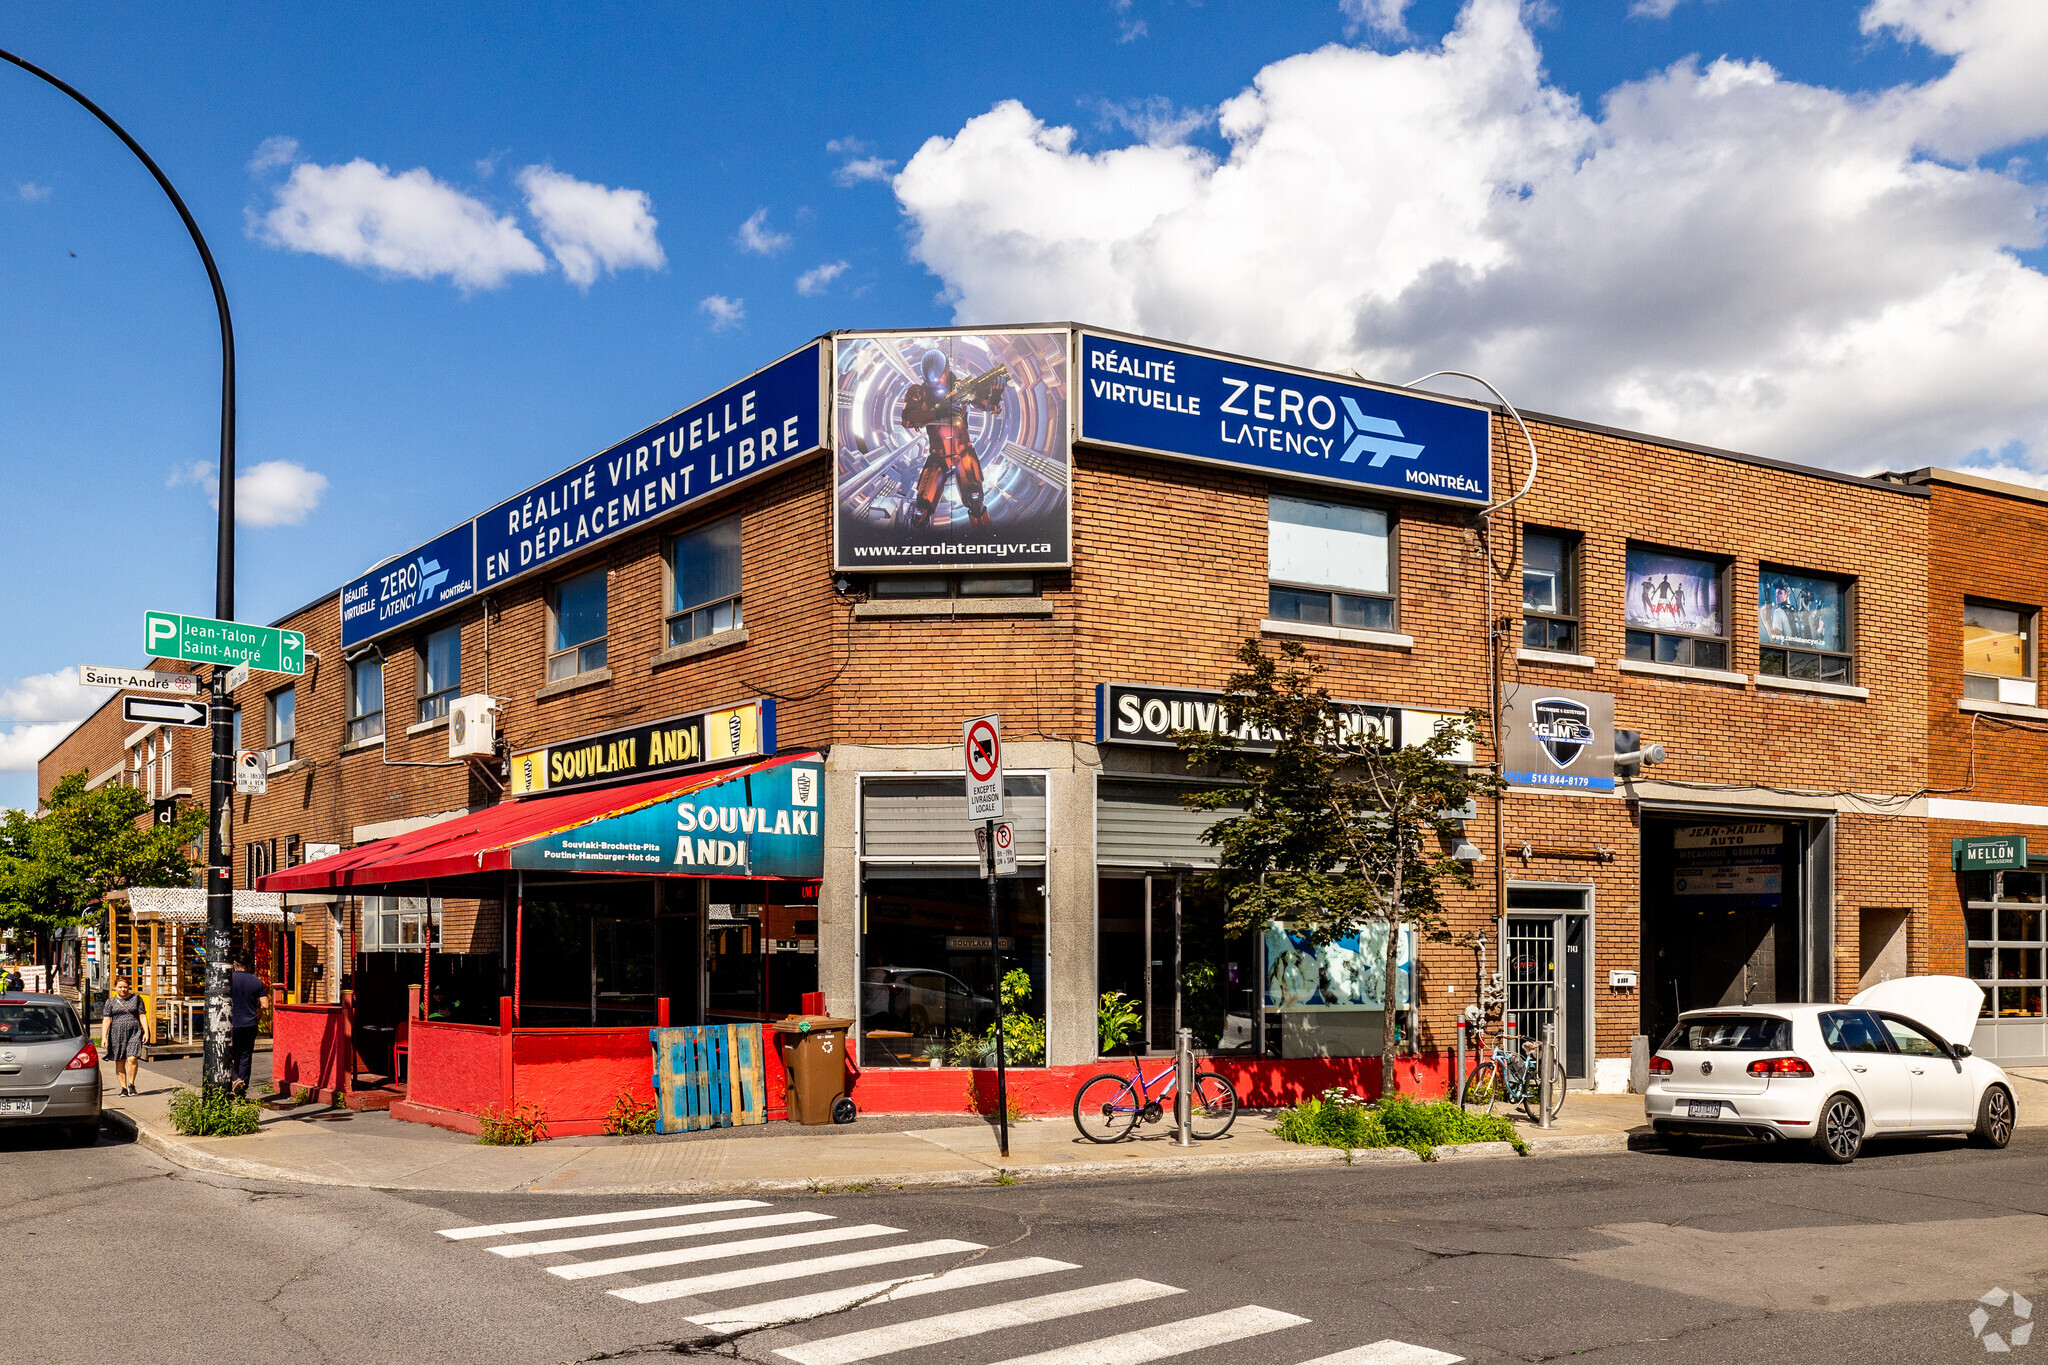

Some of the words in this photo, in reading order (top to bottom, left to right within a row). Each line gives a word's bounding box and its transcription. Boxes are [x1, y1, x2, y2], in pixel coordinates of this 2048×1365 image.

[1091, 350, 1176, 384] RÉALITÉ
[1090, 378, 1200, 416] VIRTUELLE
[1220, 376, 1336, 430] ZERO
[1222, 420, 1334, 460] LATENCY
[508, 464, 596, 536] RÉALITÉ
[608, 390, 756, 486] VIRTUELLE
[1406, 468, 1482, 494] MONTRÉAL
[486, 549, 510, 581] EN
[520, 463, 694, 566] DÉPLACEMENT
[710, 416, 798, 484] LIBRE
[854, 542, 1051, 557] www.zerolatencyvr.ca
[344, 582, 368, 604] RÉALITÉ
[380, 563, 418, 601] ZERO
[440, 580, 472, 601] MONTRÉAL
[344, 599, 376, 622] VIRTUELLE
[380, 592, 416, 620] LATENCY
[184, 624, 256, 644] Jean-Talon
[184, 641, 261, 662] Saint-André
[283, 656, 300, 672] 0.1
[86, 672, 169, 689] Saint-André
[552, 737, 636, 784] SOUVLAKI
[648, 725, 699, 766] ANDI
[1532, 772, 1547, 784] 514
[1550, 773, 1589, 786] 844-8179
[972, 793, 999, 805] LIVRAISON
[976, 803, 995, 814] LOCALE
[677, 802, 818, 837] SOUVLAKI
[562, 840, 660, 851] Souvlaki-Brochette-Pita
[674, 835, 745, 867] ANDI
[1710, 836, 1744, 845] AUTO
[544, 851, 644, 861] Poutine-Hamburger-Hot
[645, 854, 660, 862] dog
[0, 1102, 11, 1110] 95
[16, 1102, 30, 1110] WRA
